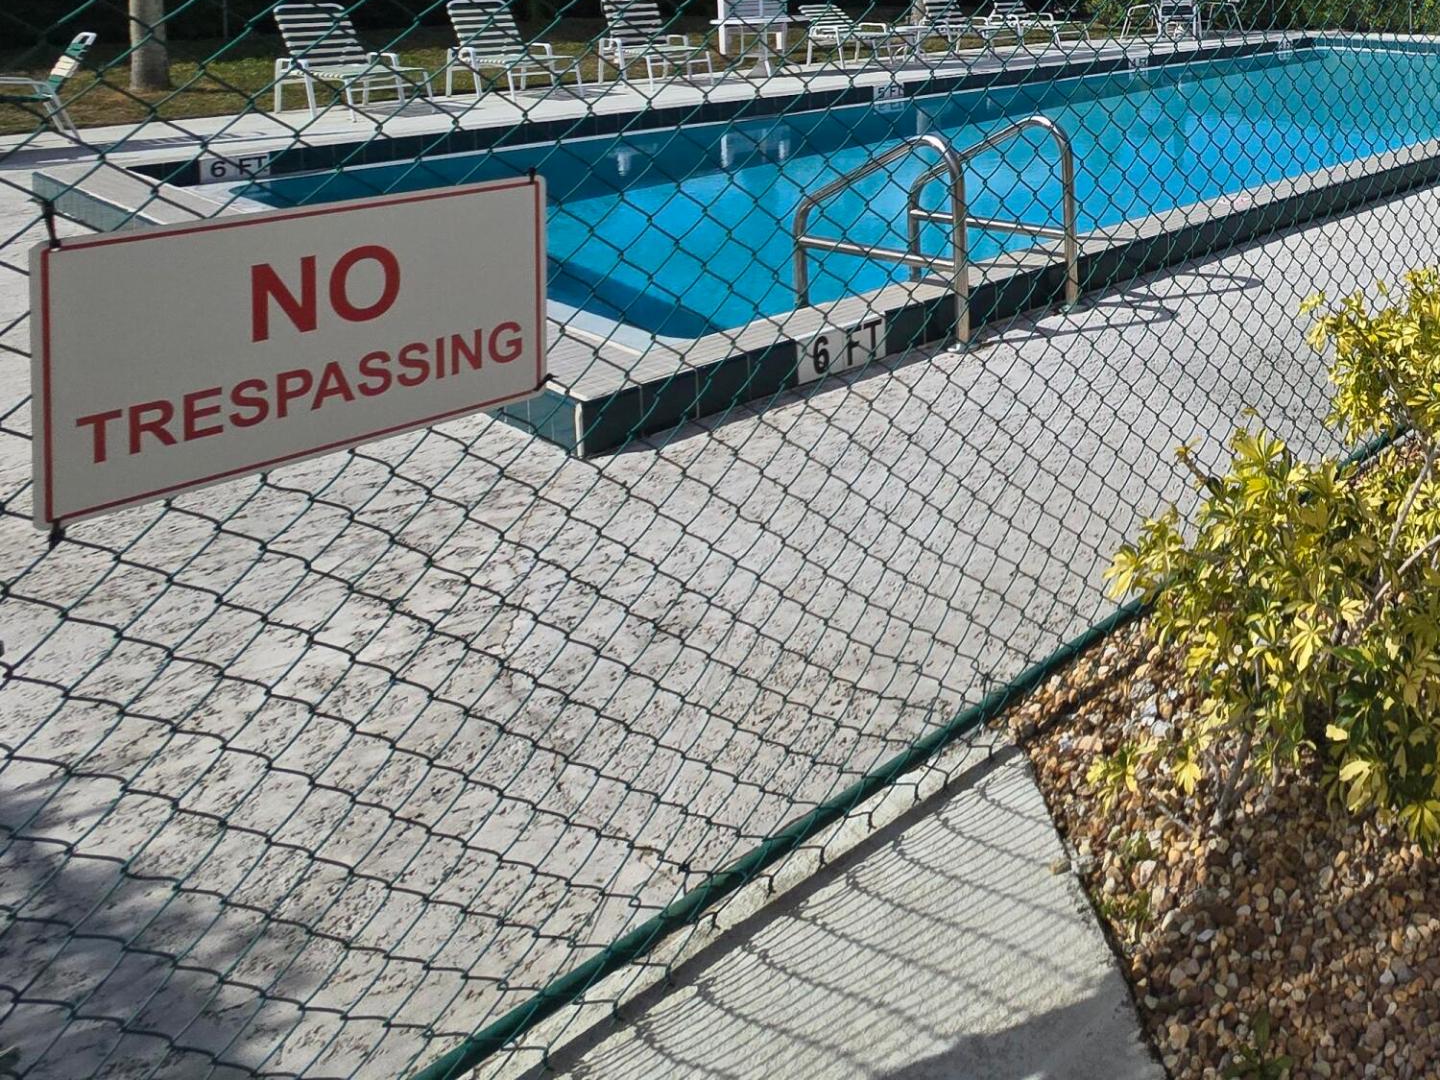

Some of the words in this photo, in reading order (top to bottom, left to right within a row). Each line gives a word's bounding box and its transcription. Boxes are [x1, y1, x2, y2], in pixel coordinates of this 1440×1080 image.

[210, 160, 226, 177] 6
[238, 155, 268, 175] FT
[250, 244, 401, 343] NO
[813, 335, 830, 375] 6
[846, 318, 882, 366] FT
[75, 321, 524, 465] TRESPASSING
